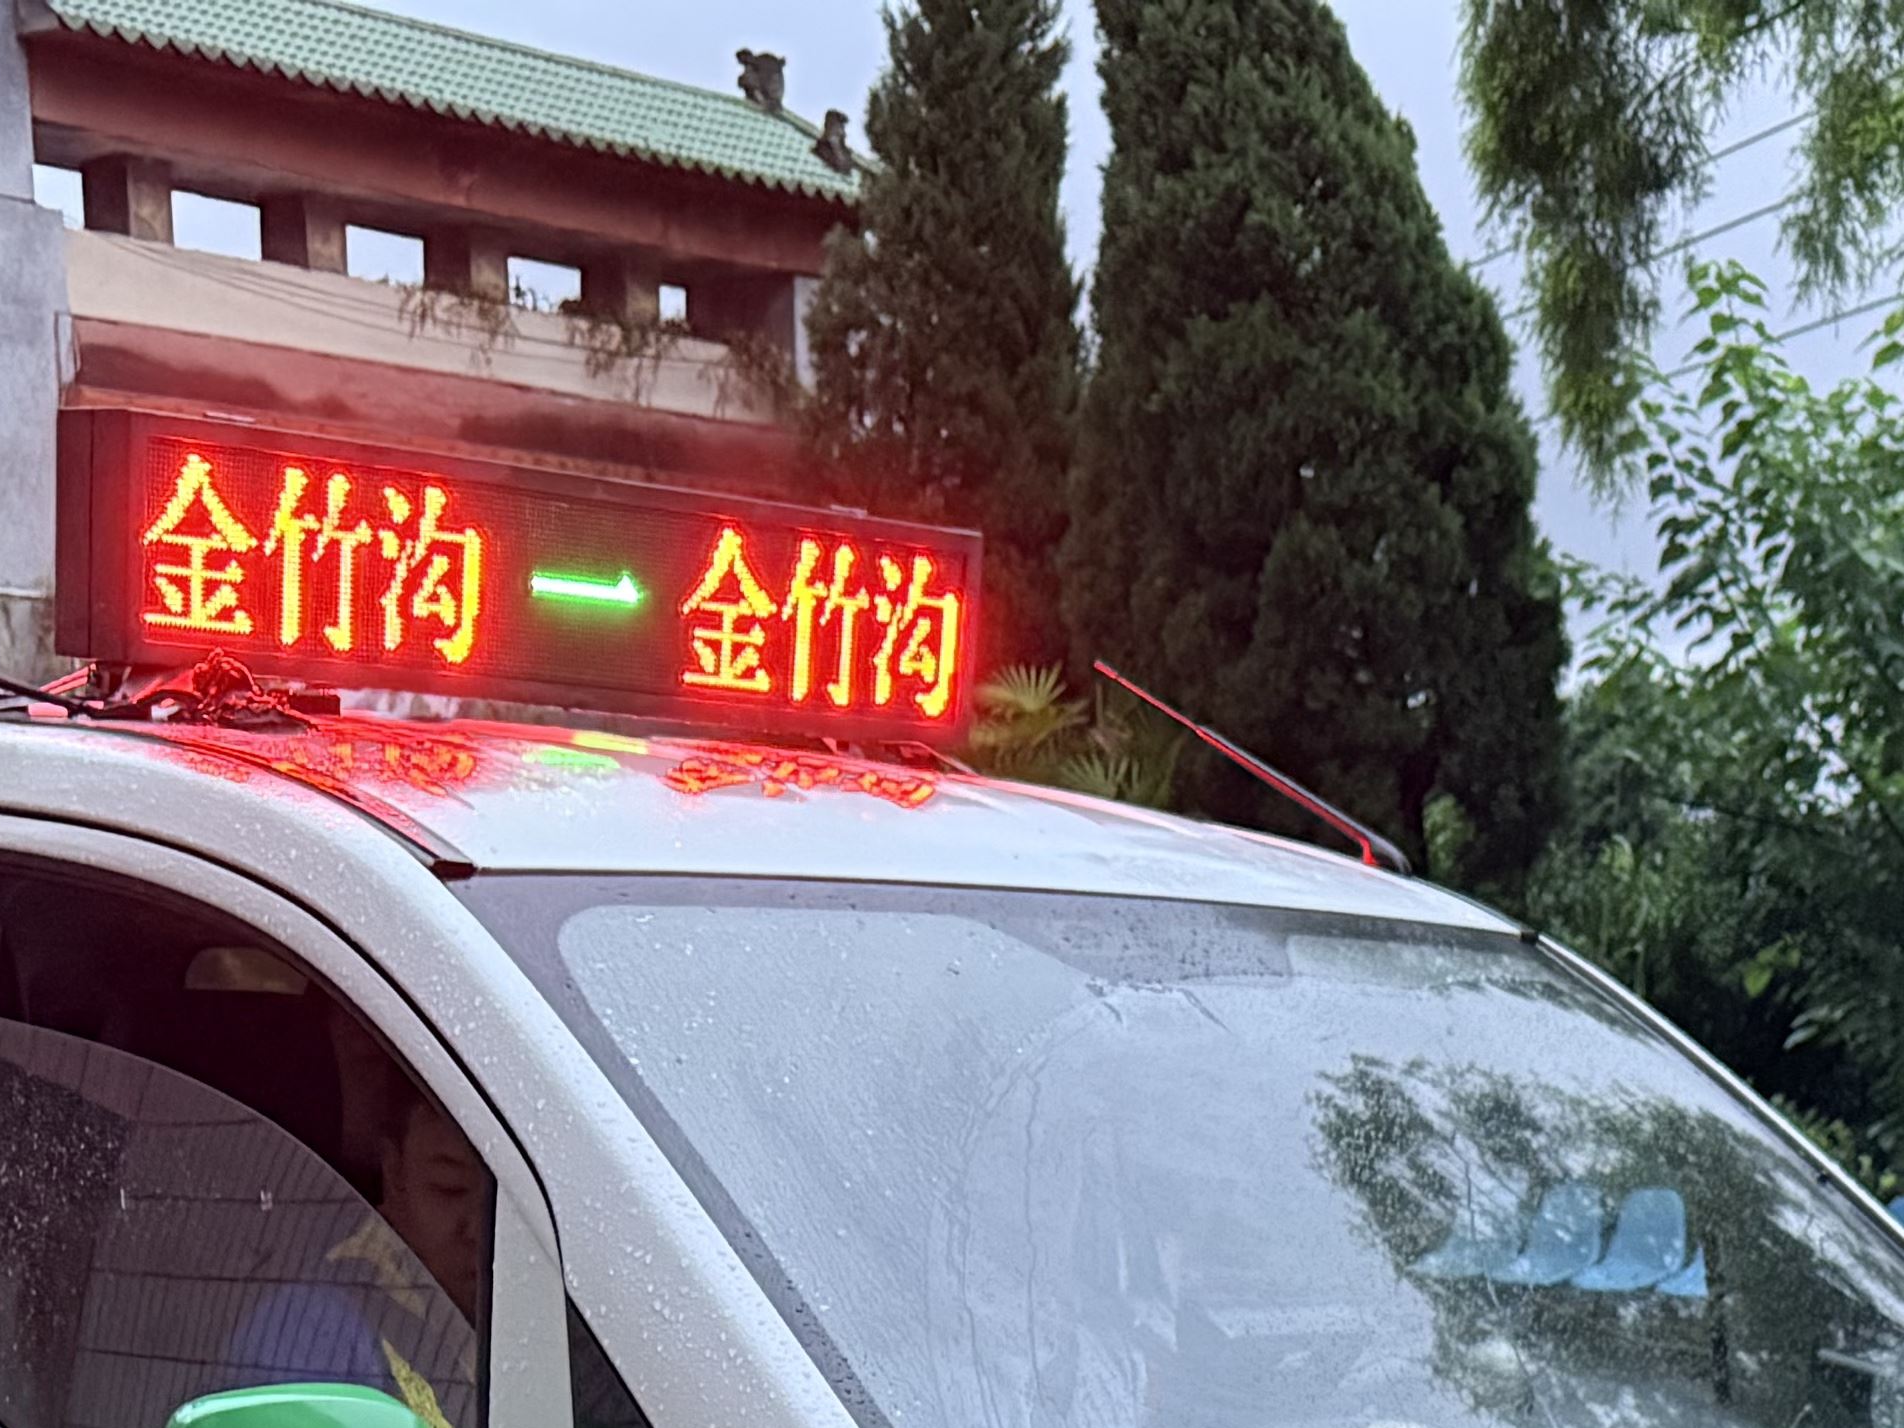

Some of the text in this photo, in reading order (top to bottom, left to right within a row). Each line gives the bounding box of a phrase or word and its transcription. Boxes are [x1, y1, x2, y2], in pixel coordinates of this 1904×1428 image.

[141, 452, 962, 719] 金竹沟 金竹沟
